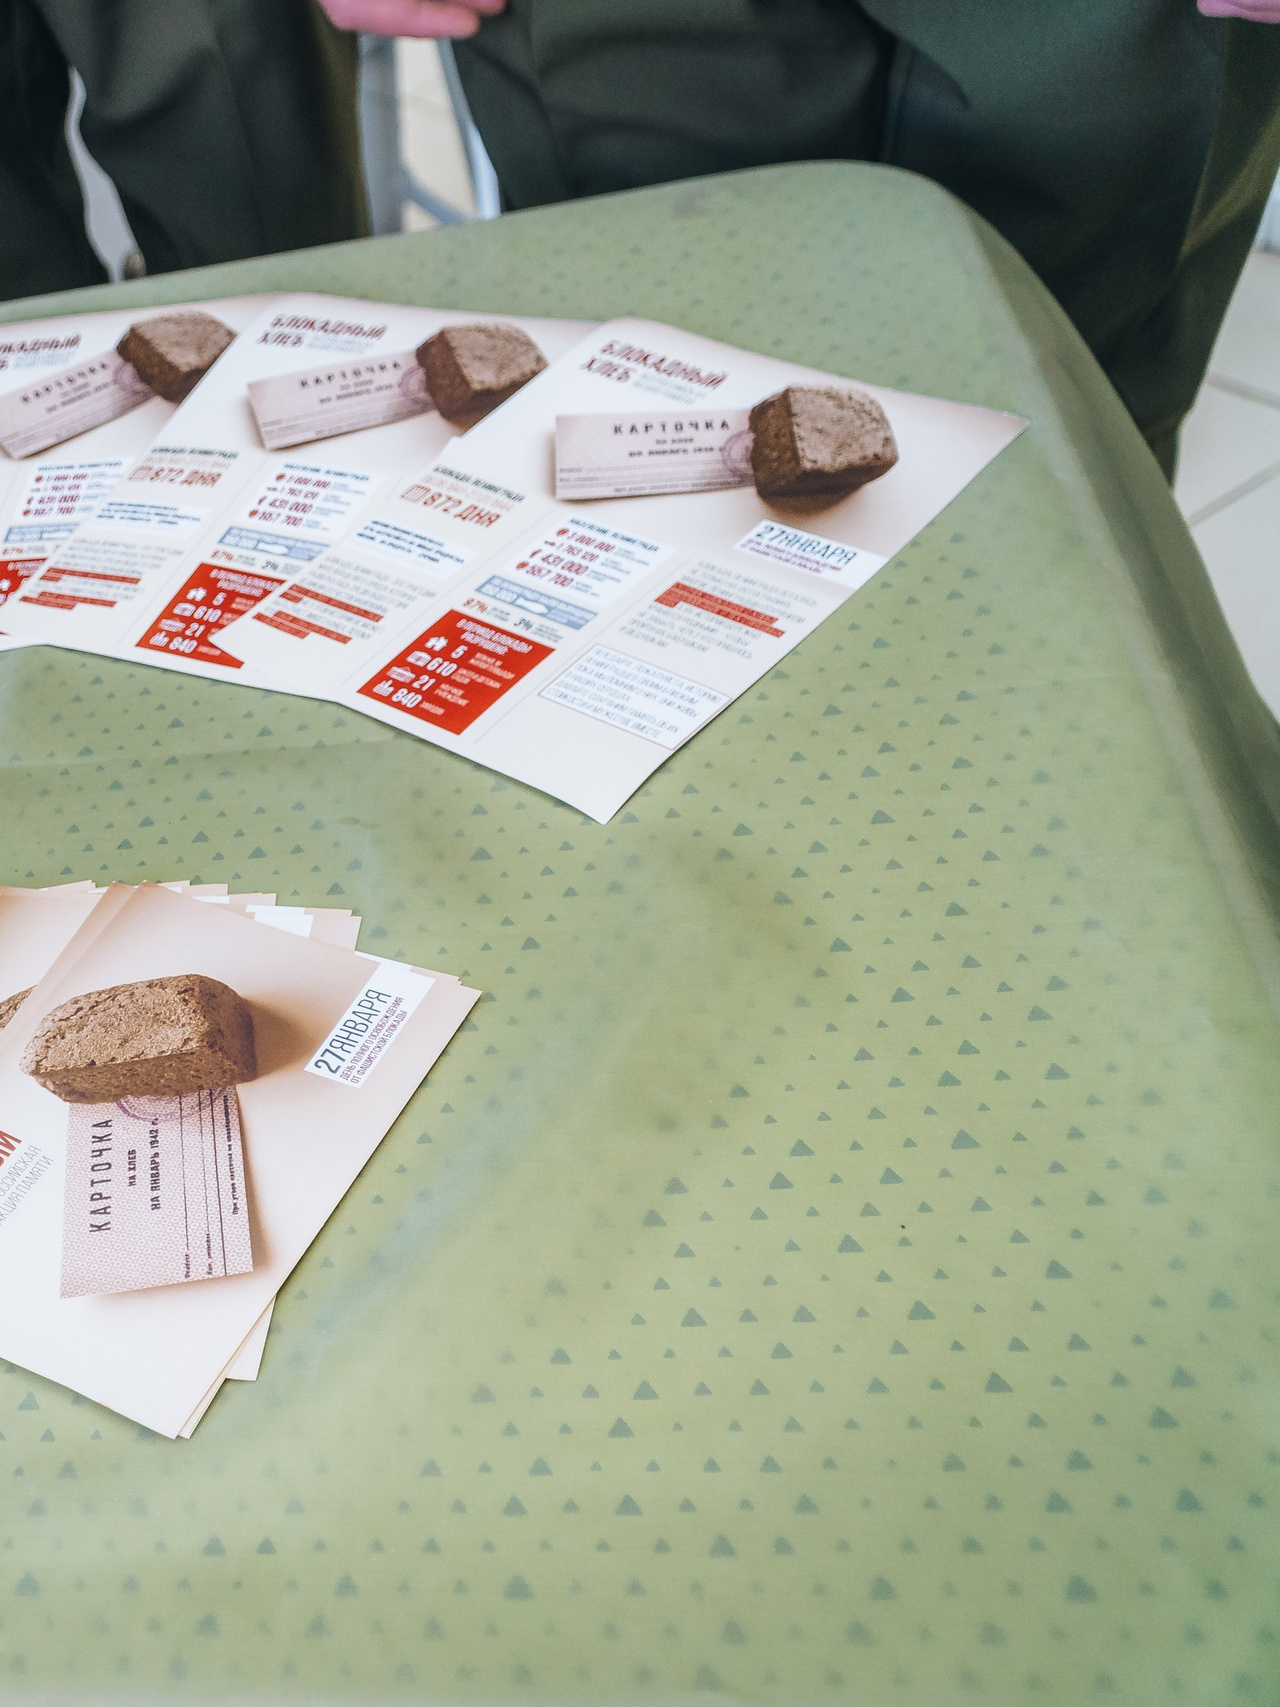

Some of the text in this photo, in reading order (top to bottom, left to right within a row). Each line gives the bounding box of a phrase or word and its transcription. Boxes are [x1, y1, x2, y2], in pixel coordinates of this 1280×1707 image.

[613, 419, 731, 434] КАРТОЧКА
[422, 491, 463, 514] 872
[453, 504, 501, 529] ДНЯ
[212, 592, 228, 606] 5
[193, 605, 223, 624] 610
[184, 622, 206, 638] 21
[168, 636, 199, 654] 840
[451, 645, 468, 659] 5
[426, 656, 458, 677] 610
[412, 674, 436, 691] 21
[391, 688, 423, 709] 840
[340, 996, 404, 1081] ДЕНЬ ПОЛНОГО ОСВОБОЖДЕНИЯ
[350, 1011, 408, 1084] ОТ ФАШИСТСКОЙ БЛОКАДЫ
[149, 1128, 159, 1149] 1942
[16, 1155, 55, 1195] ПАМЯТИ
[89, 1119, 113, 1233] КАРТОЧКА
[128, 1149, 137, 1187] НА ХЛЕБ
[150, 1152, 161, 1191] ЯНВАРЬ
[151, 1200, 161, 1212] НА
